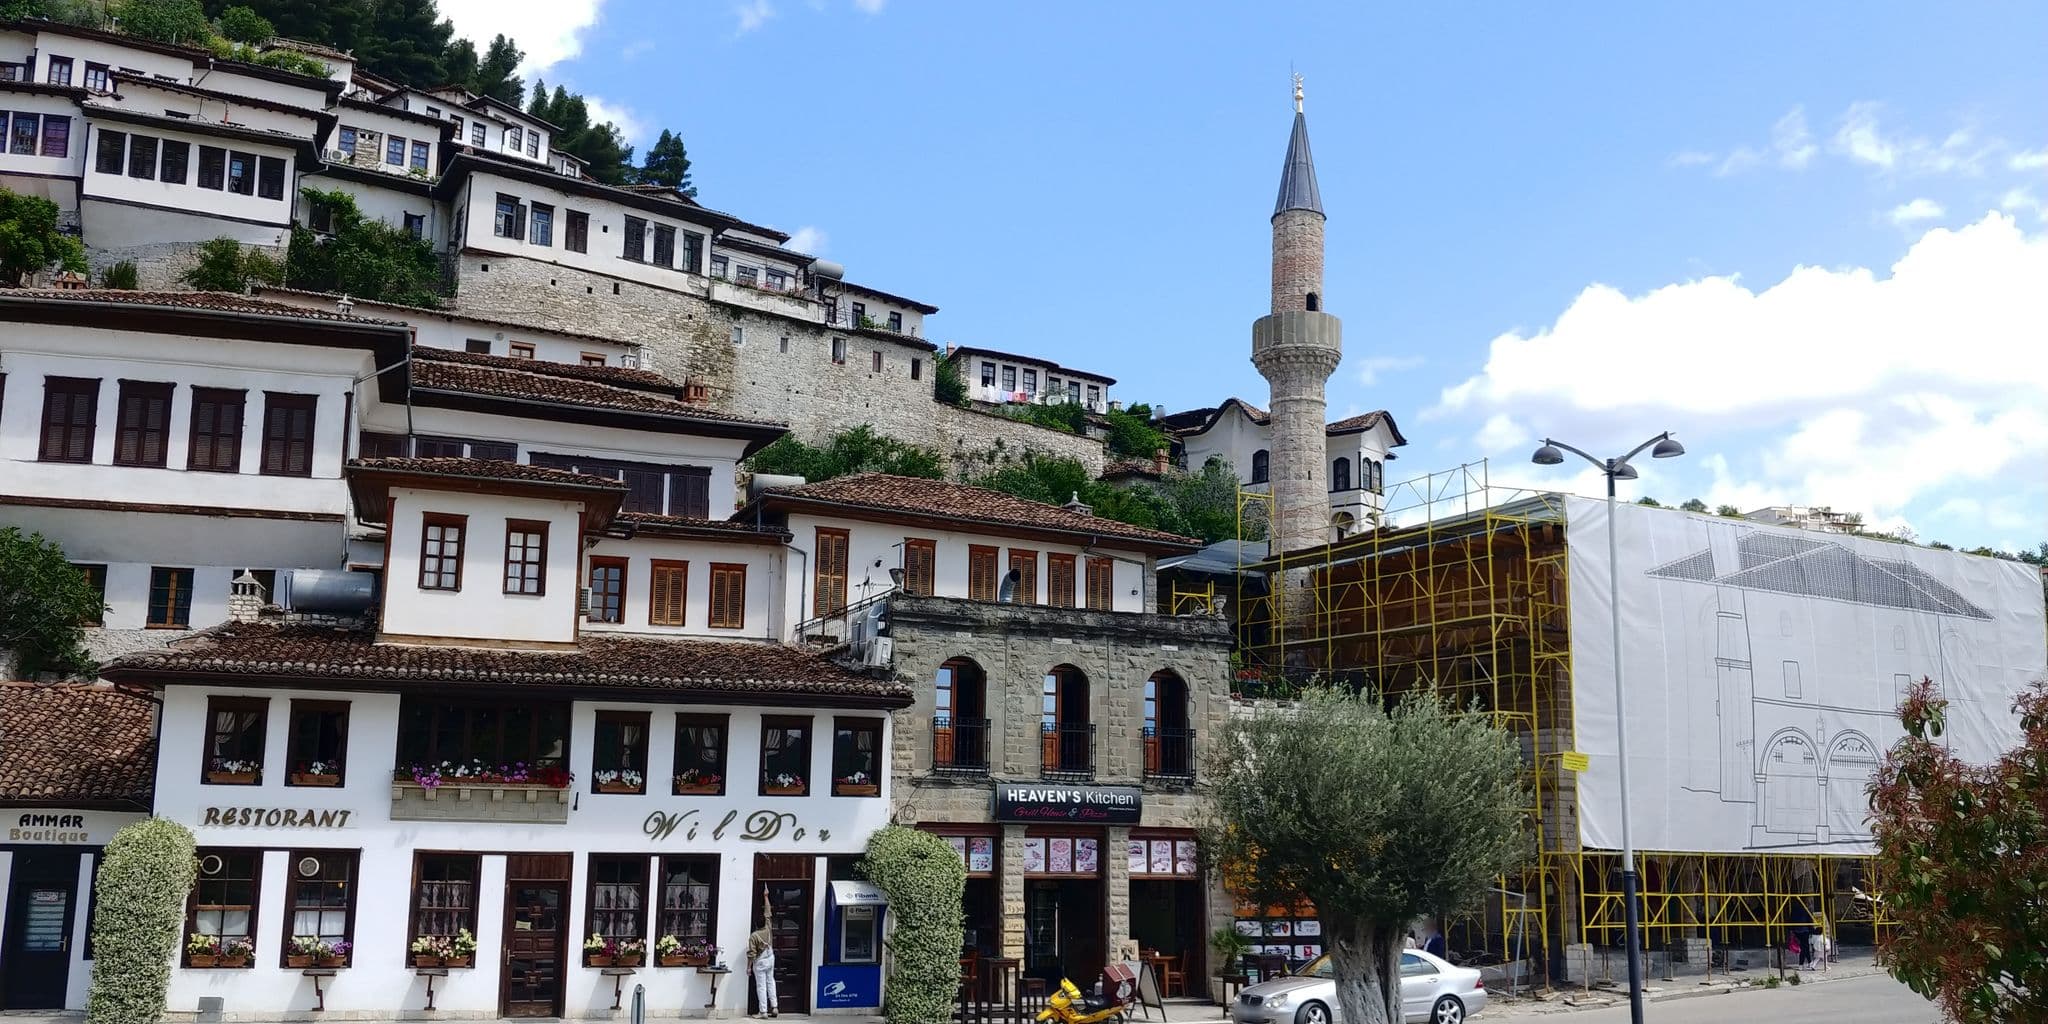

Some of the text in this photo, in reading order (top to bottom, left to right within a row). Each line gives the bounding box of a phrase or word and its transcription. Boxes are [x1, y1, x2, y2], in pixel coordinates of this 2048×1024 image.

[1008, 789, 1134, 805] HEAVEN'S Kitchen
[204, 807, 351, 828] RESTORANT
[1068, 807, 1078, 818] &
[19, 813, 84, 829] AMMAR
[9, 828, 88, 844] Boutique
